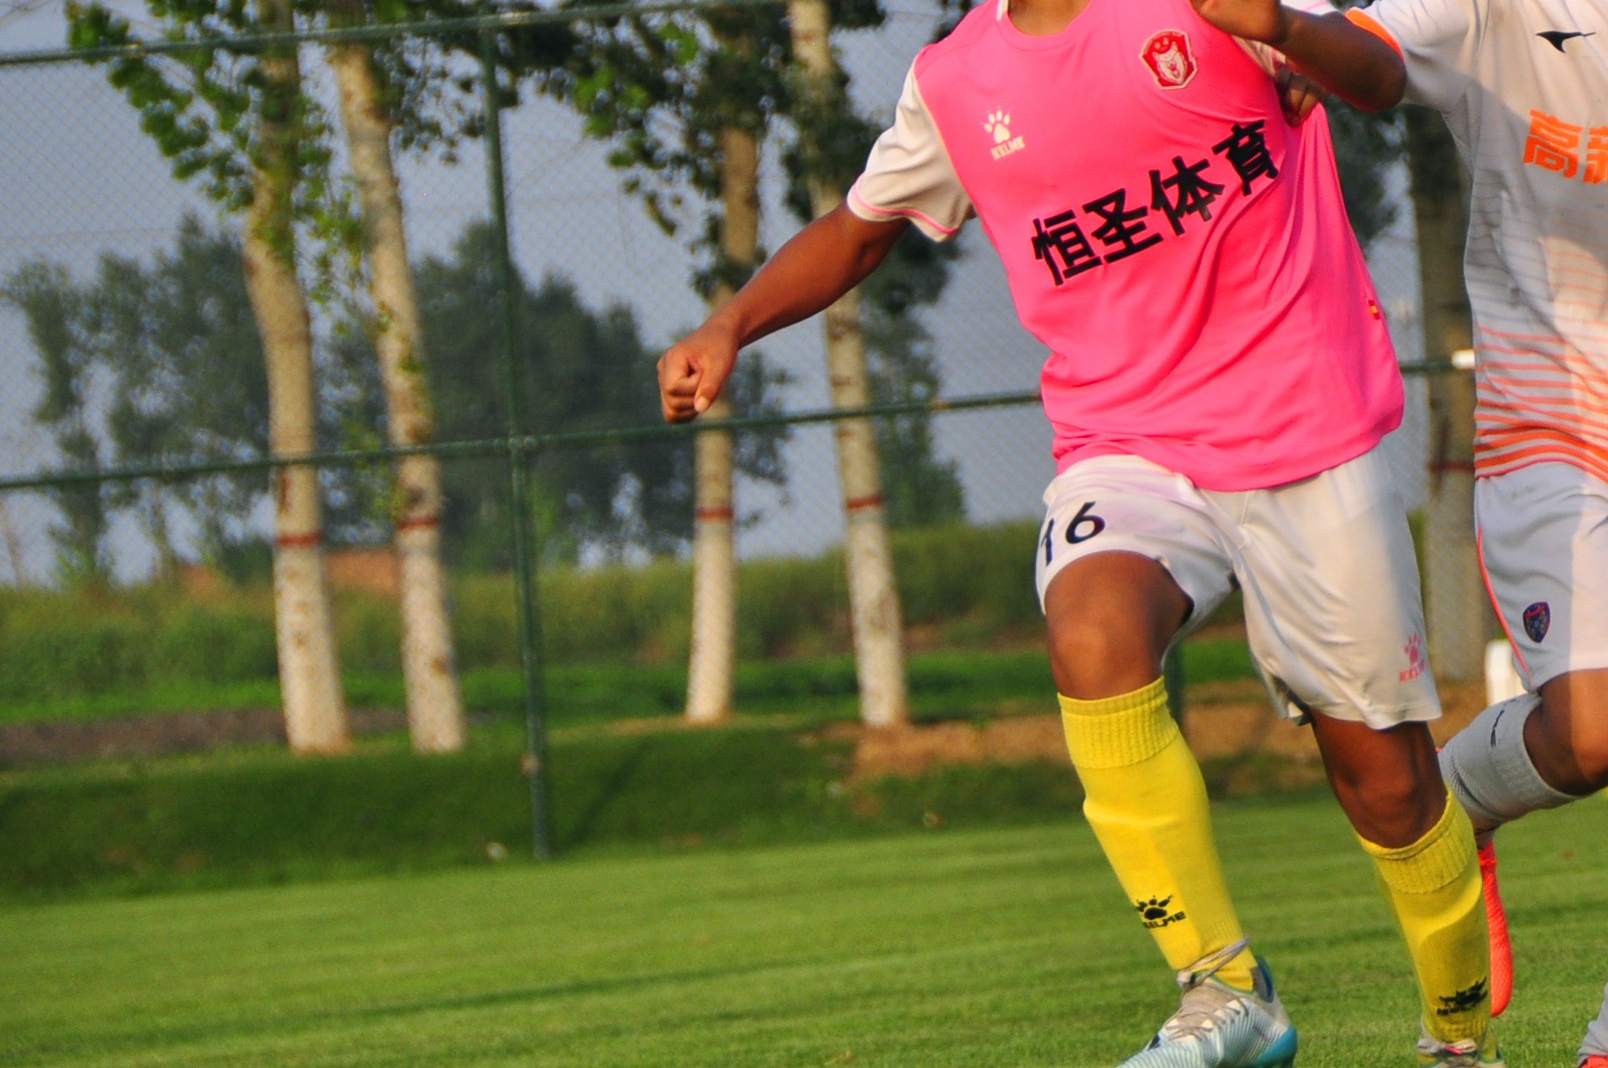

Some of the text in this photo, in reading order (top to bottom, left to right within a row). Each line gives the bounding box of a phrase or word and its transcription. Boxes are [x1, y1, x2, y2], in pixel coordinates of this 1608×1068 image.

[1030, 120, 1279, 286] 恒圣体育
[1040, 500, 1106, 567] 16
